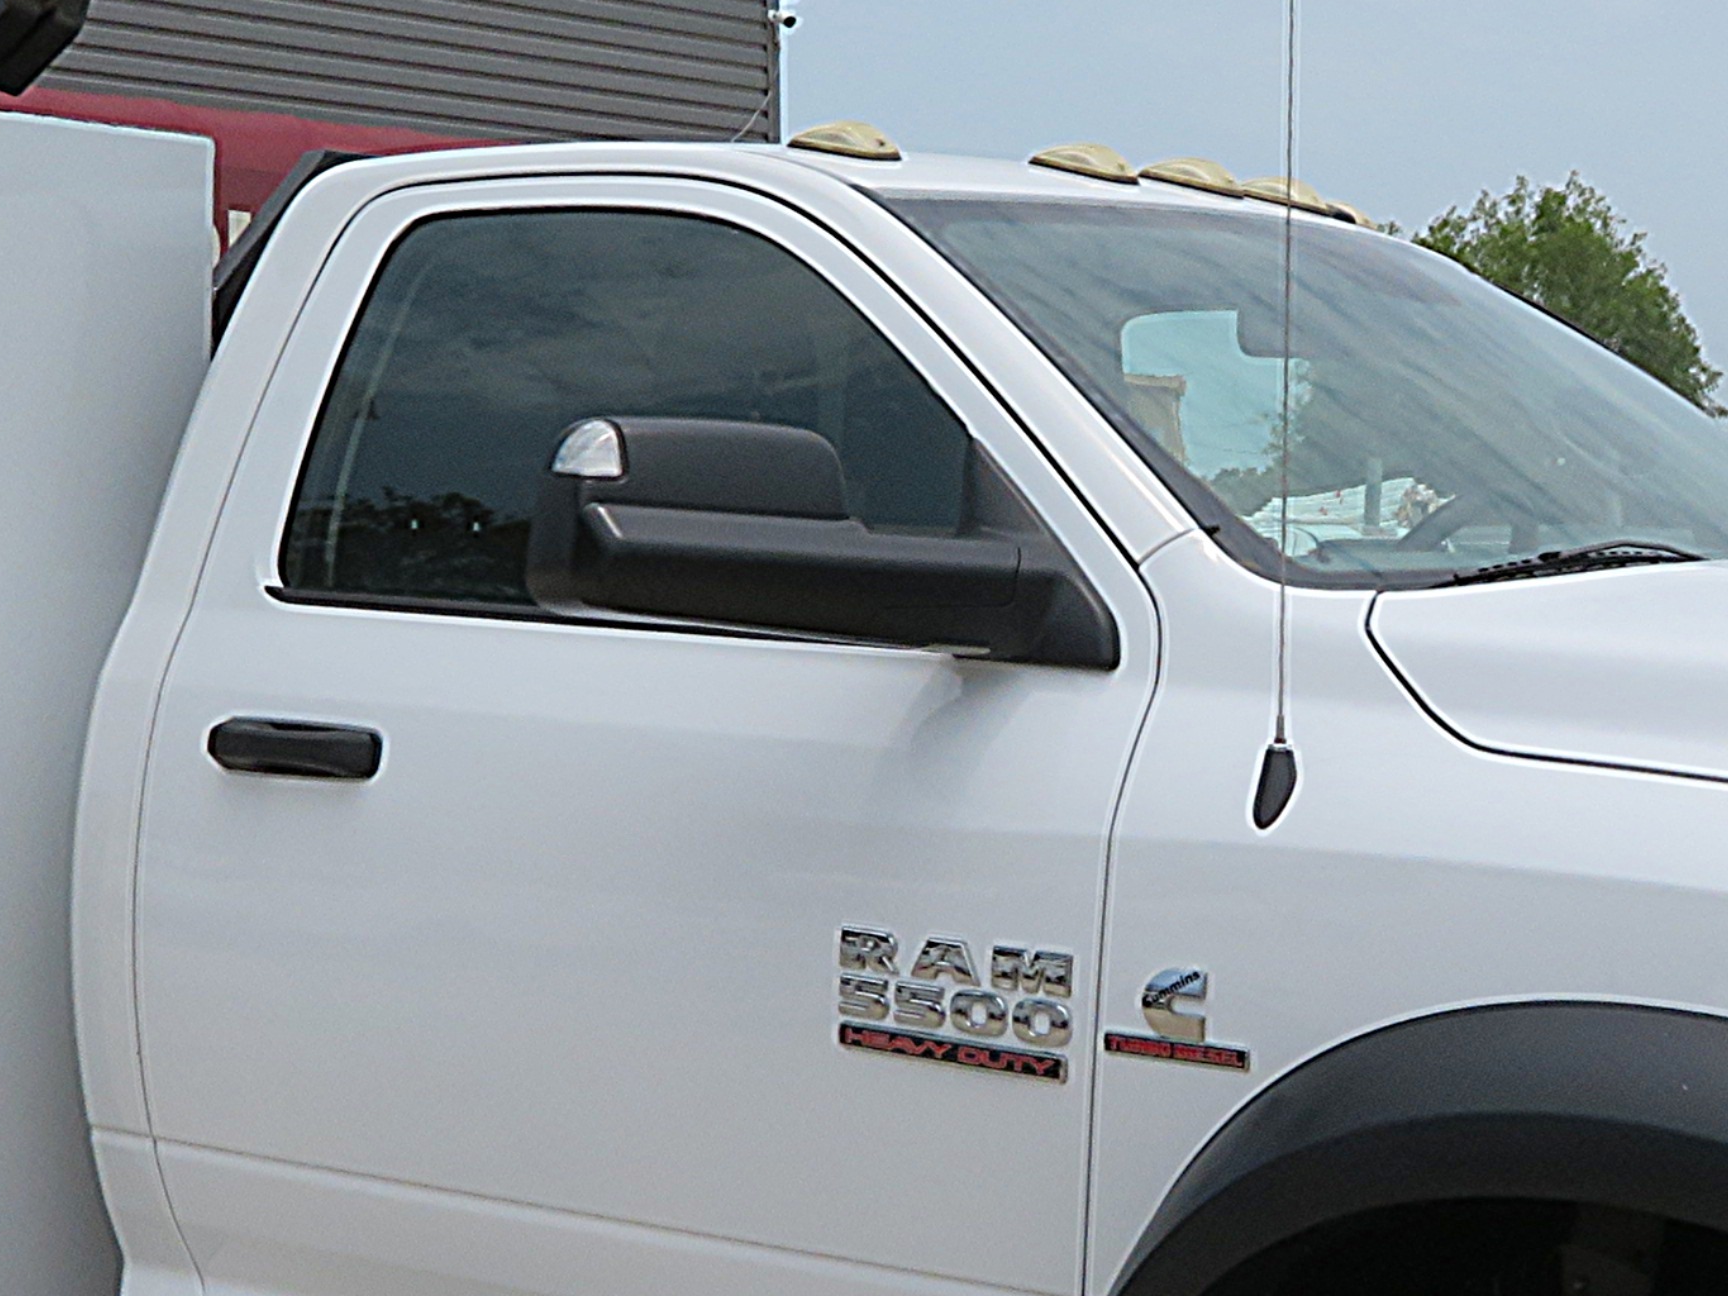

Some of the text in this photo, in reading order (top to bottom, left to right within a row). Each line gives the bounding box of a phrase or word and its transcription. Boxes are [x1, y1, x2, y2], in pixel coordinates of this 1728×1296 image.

[838, 924, 1074, 998] RAM
[837, 972, 1074, 1047] 5500
[1141, 970, 1201, 1008] Cummins
[844, 1028, 1056, 1076] HEAVY DUTY
[1108, 1034, 1244, 1068] TURBO DIESEL
